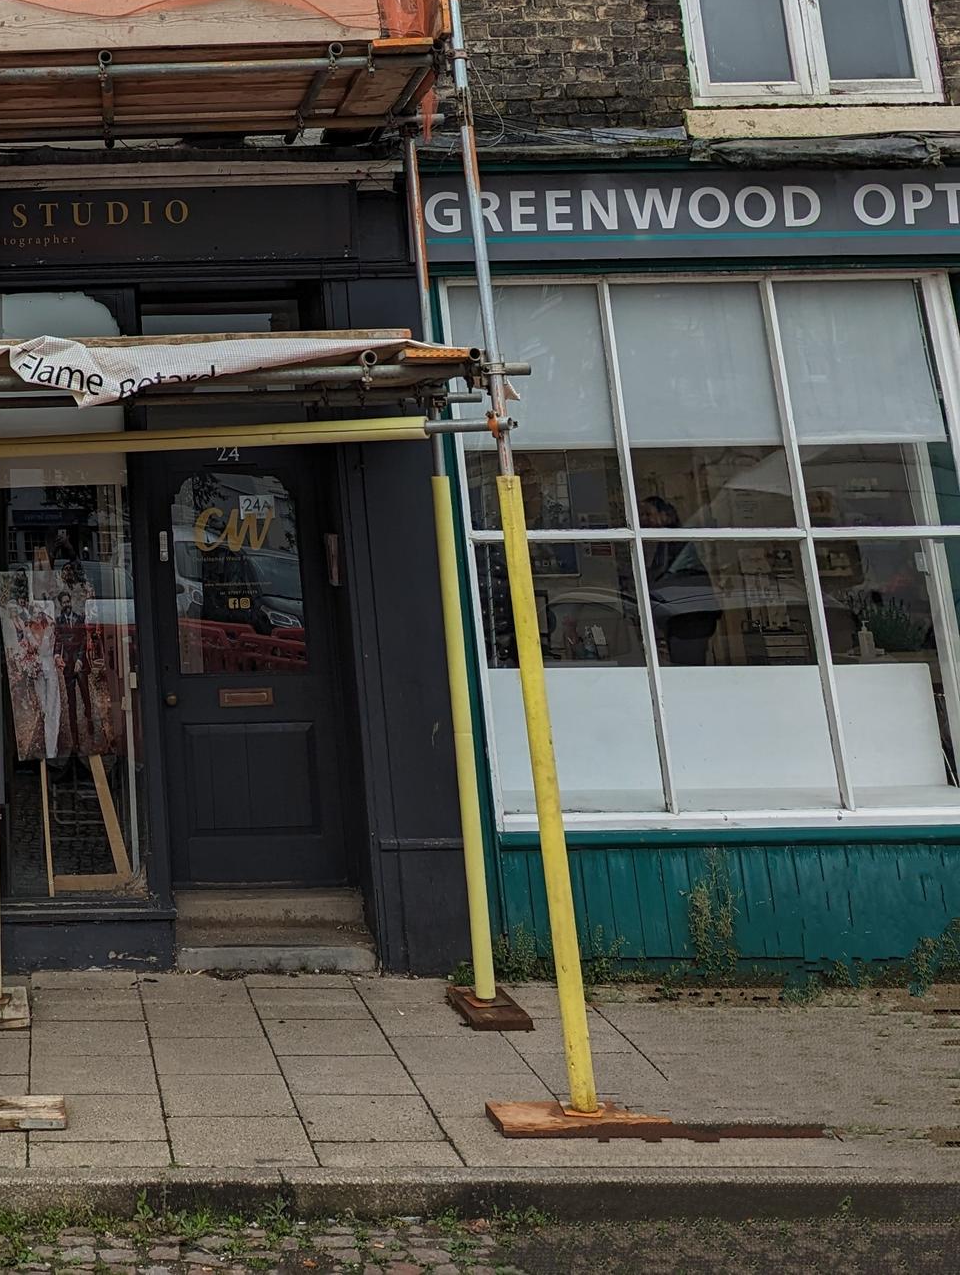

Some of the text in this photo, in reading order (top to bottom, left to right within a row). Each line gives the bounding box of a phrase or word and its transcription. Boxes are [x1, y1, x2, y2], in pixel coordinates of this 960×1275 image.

[12, 199, 189, 228] STUDIO
[424, 183, 960, 233] GREENWOOD OPT
[217, 447, 240, 461] 24
[243, 498, 272, 512] 24A
